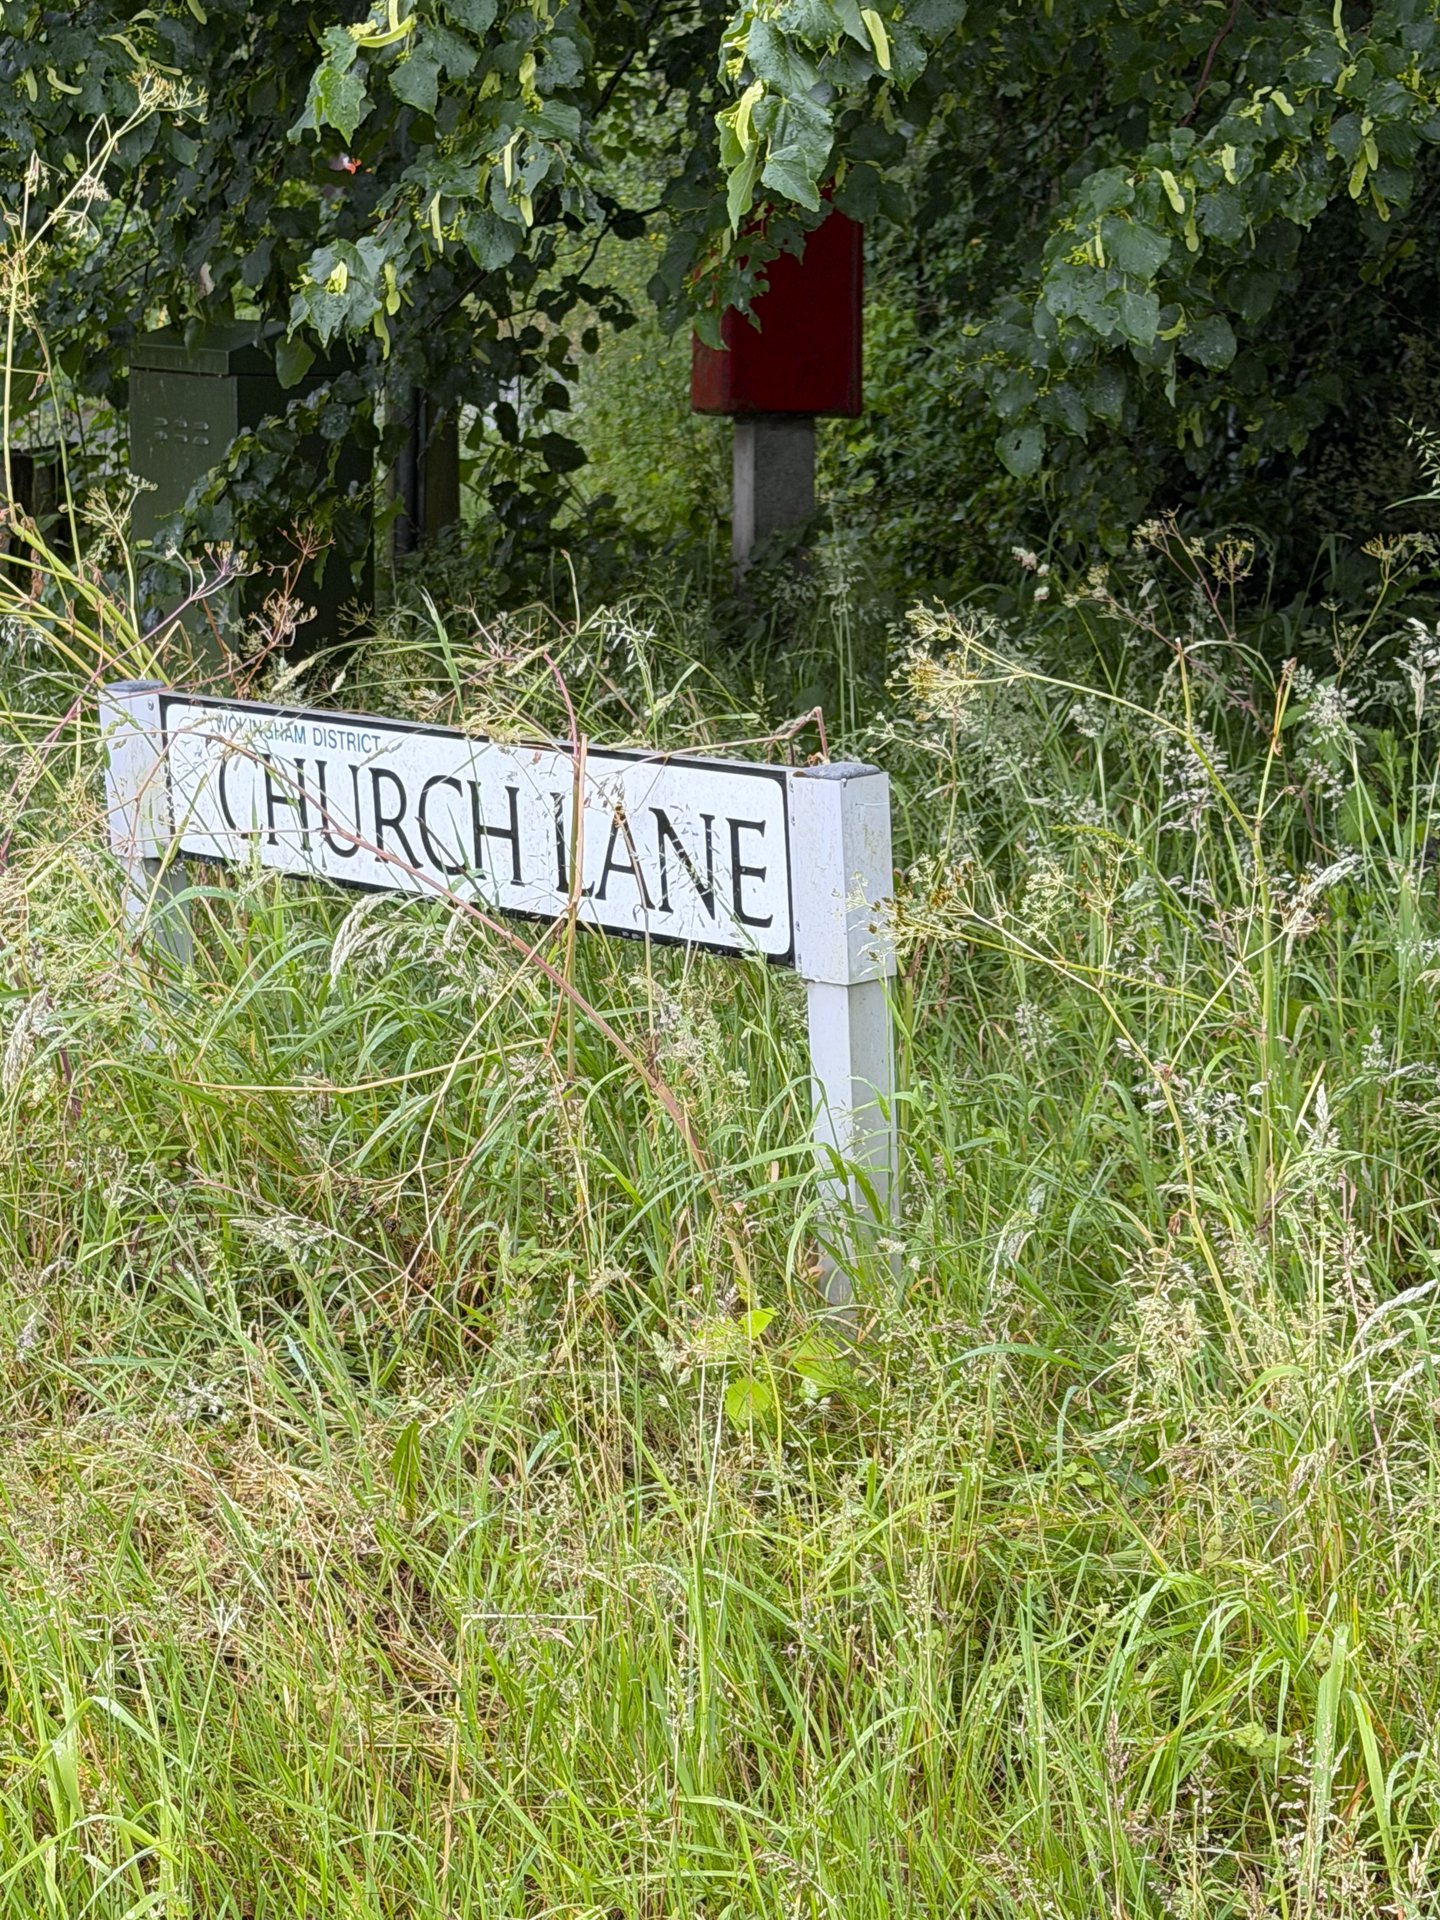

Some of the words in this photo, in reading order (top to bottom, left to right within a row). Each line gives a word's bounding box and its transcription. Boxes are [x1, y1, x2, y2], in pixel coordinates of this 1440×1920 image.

[313, 727, 381, 753] DISTRICT
[219, 752, 524, 886] CHURCH
[550, 791, 774, 928] LANE
